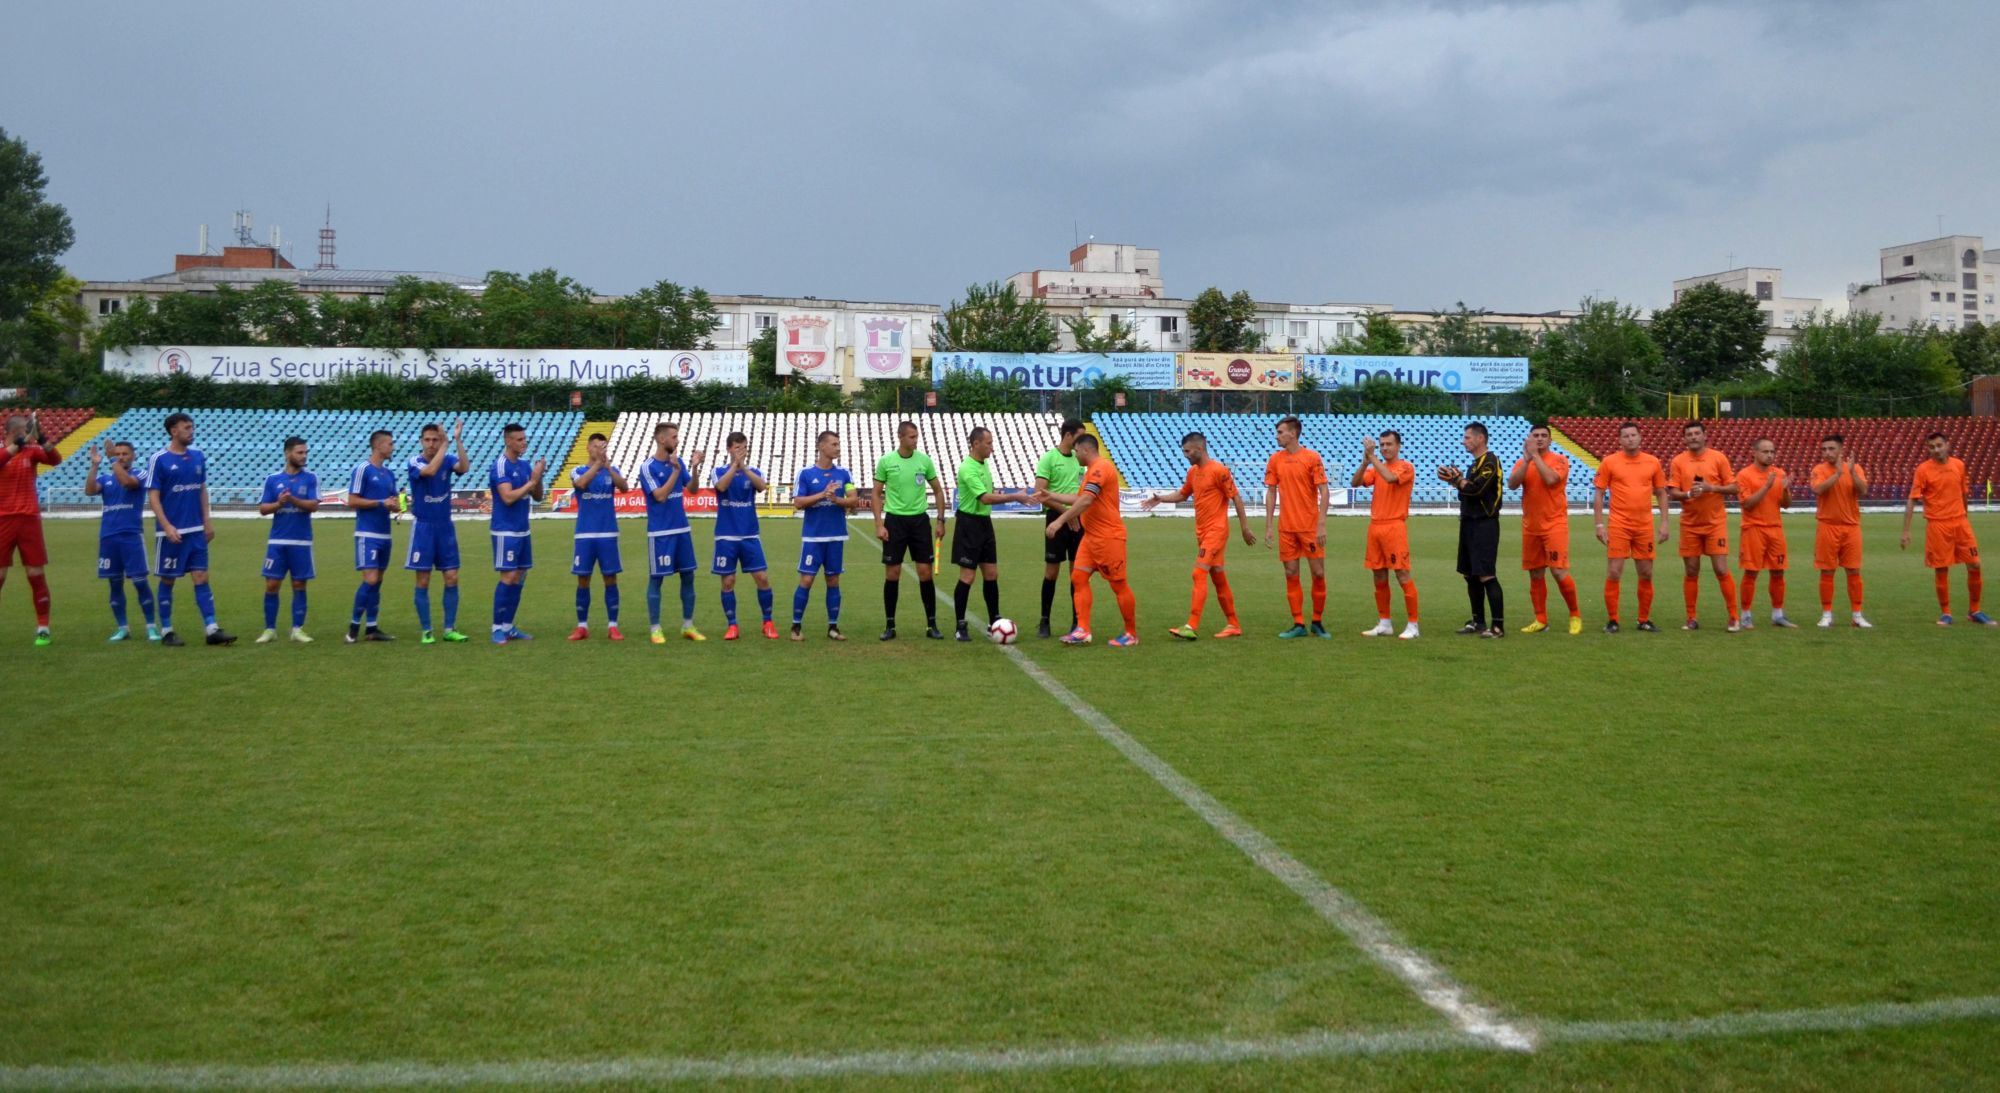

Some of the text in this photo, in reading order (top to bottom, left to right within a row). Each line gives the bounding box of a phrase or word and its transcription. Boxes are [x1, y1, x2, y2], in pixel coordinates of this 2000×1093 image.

[211, 356, 260, 377] Ziua
[538, 358, 559, 379] în
[570, 358, 651, 380] Muncă
[1354, 358, 1394, 367] Grande
[1228, 365, 1250, 374] Grande
[370, 549, 377, 560] 7
[164, 557, 178, 569] 21
[658, 555, 671, 567] 10
[716, 556, 727, 567] 13
